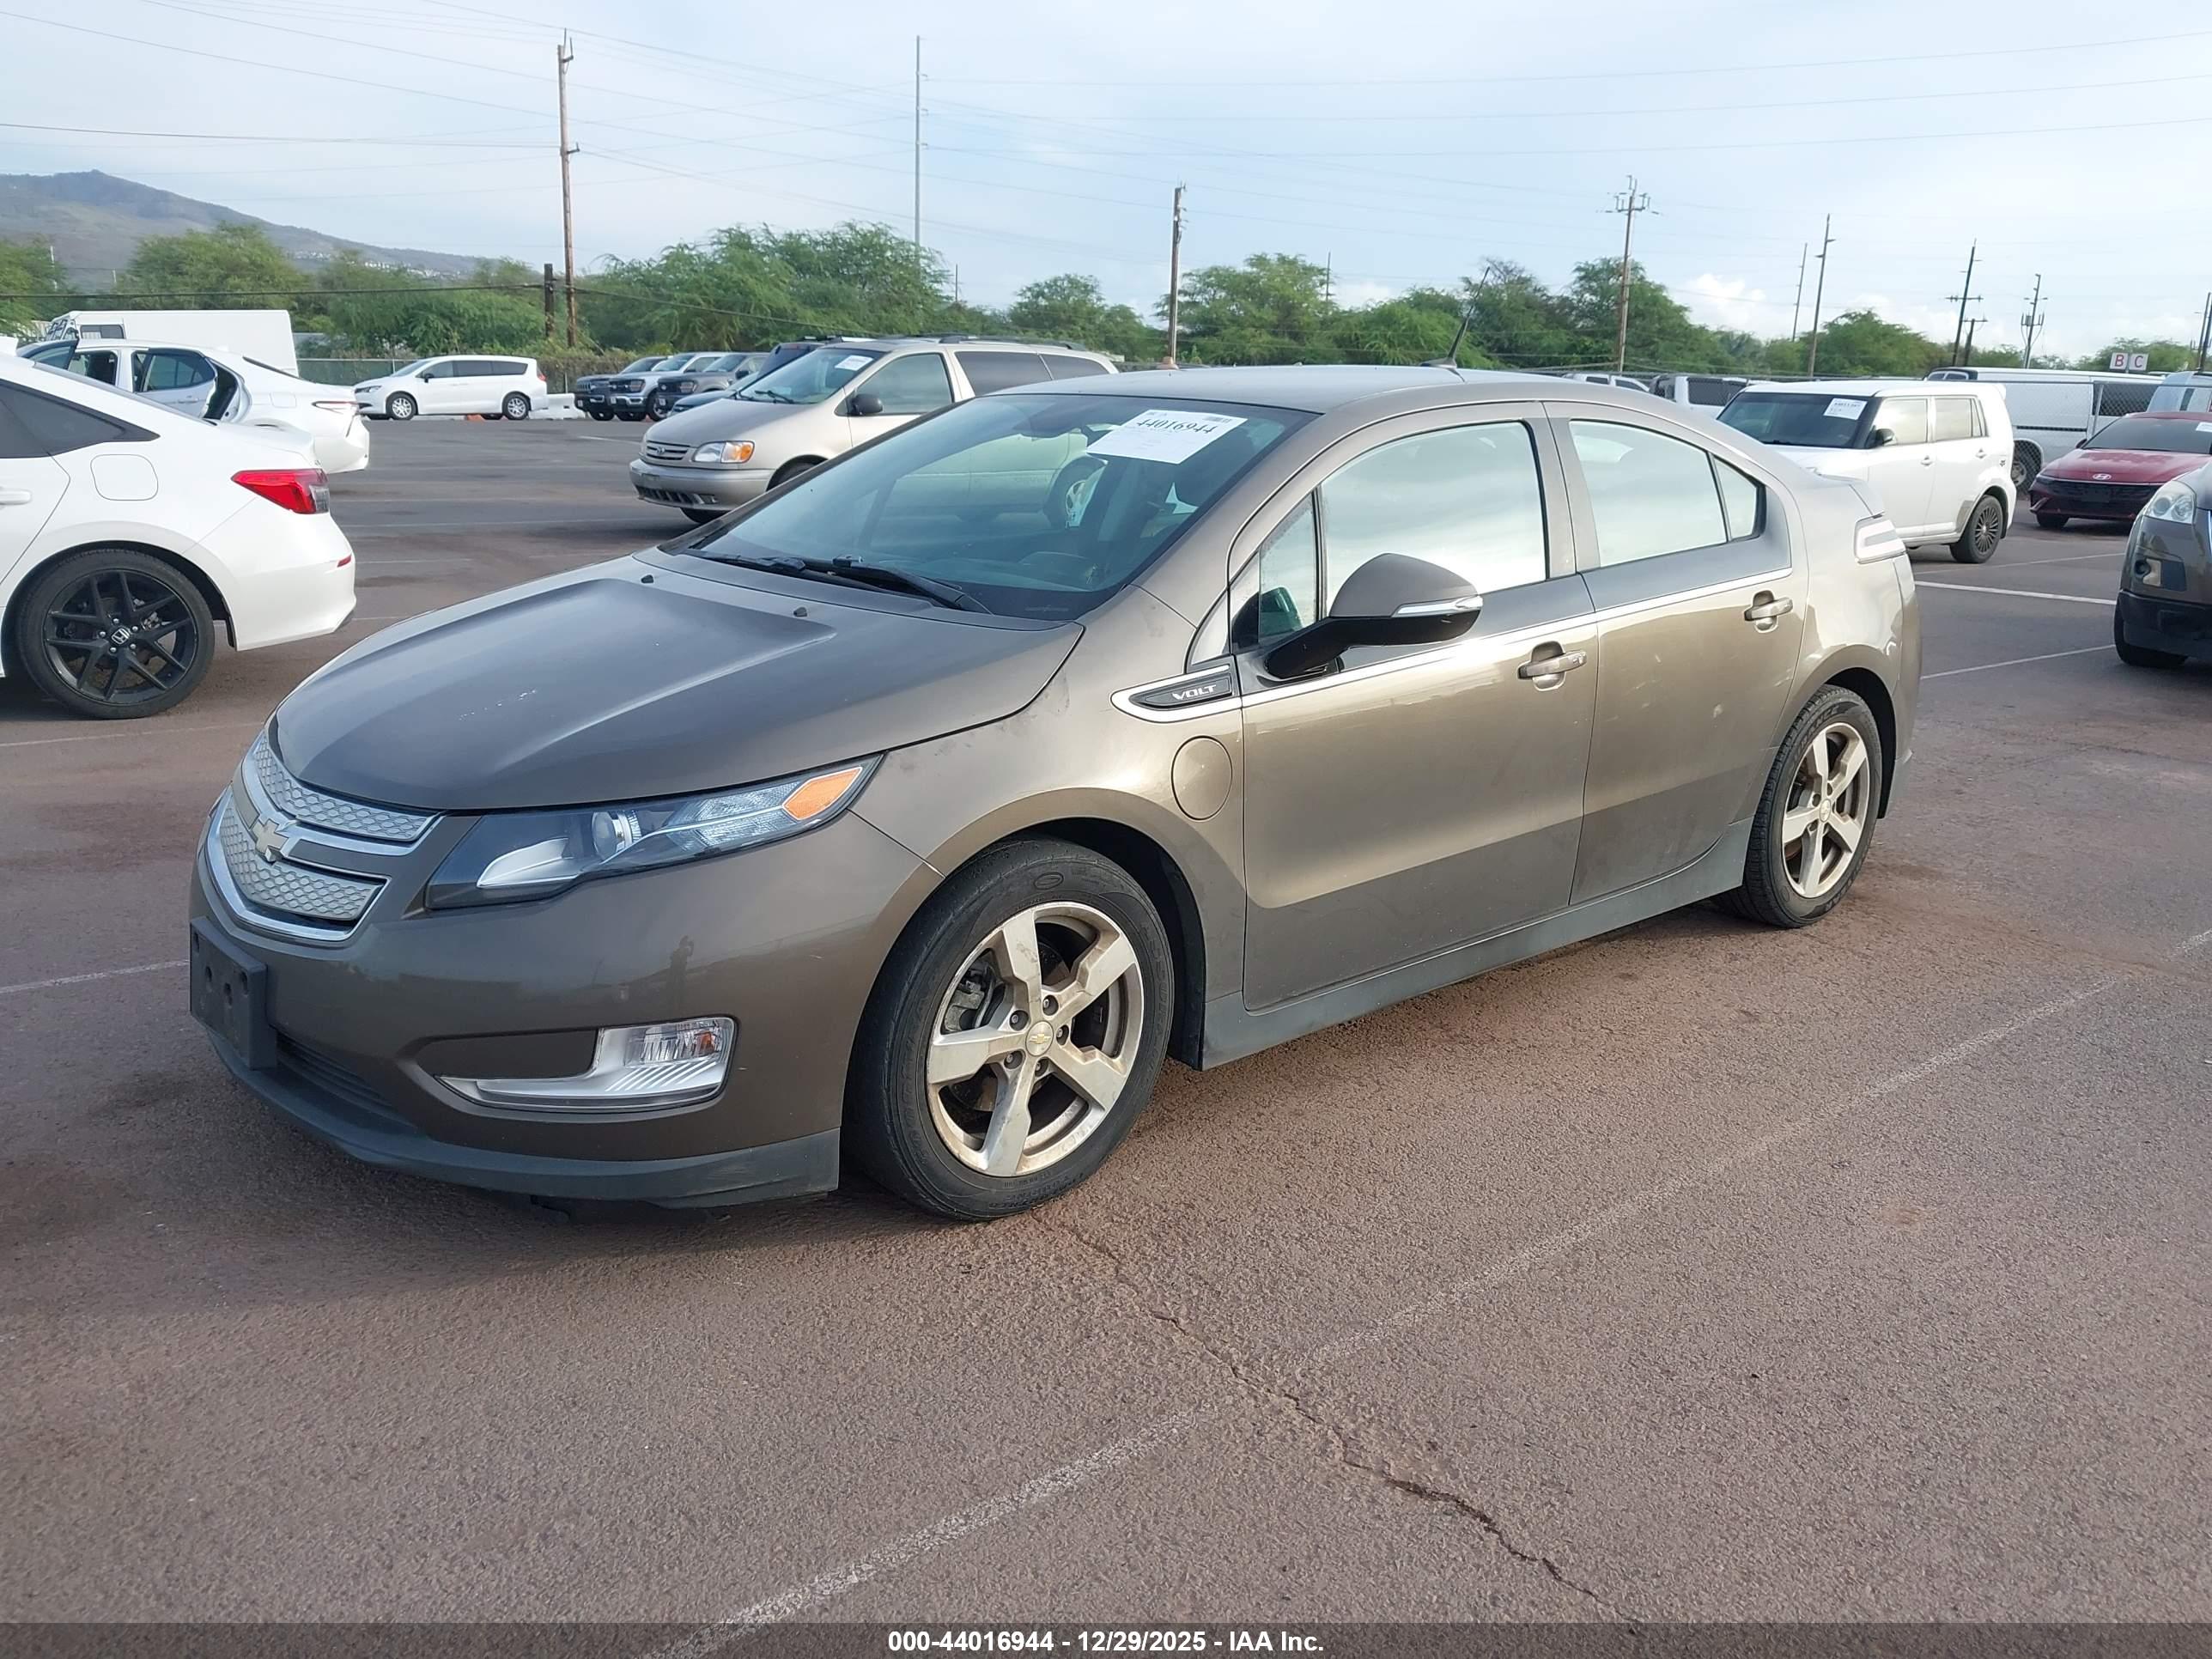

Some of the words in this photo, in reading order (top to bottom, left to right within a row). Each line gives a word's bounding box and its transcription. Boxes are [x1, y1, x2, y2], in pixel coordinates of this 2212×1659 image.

[2114, 354, 2125, 368] B
[2134, 355, 2144, 368] C
[1137, 418, 1218, 434] 44016944
[1172, 684, 1217, 702] VOLT
